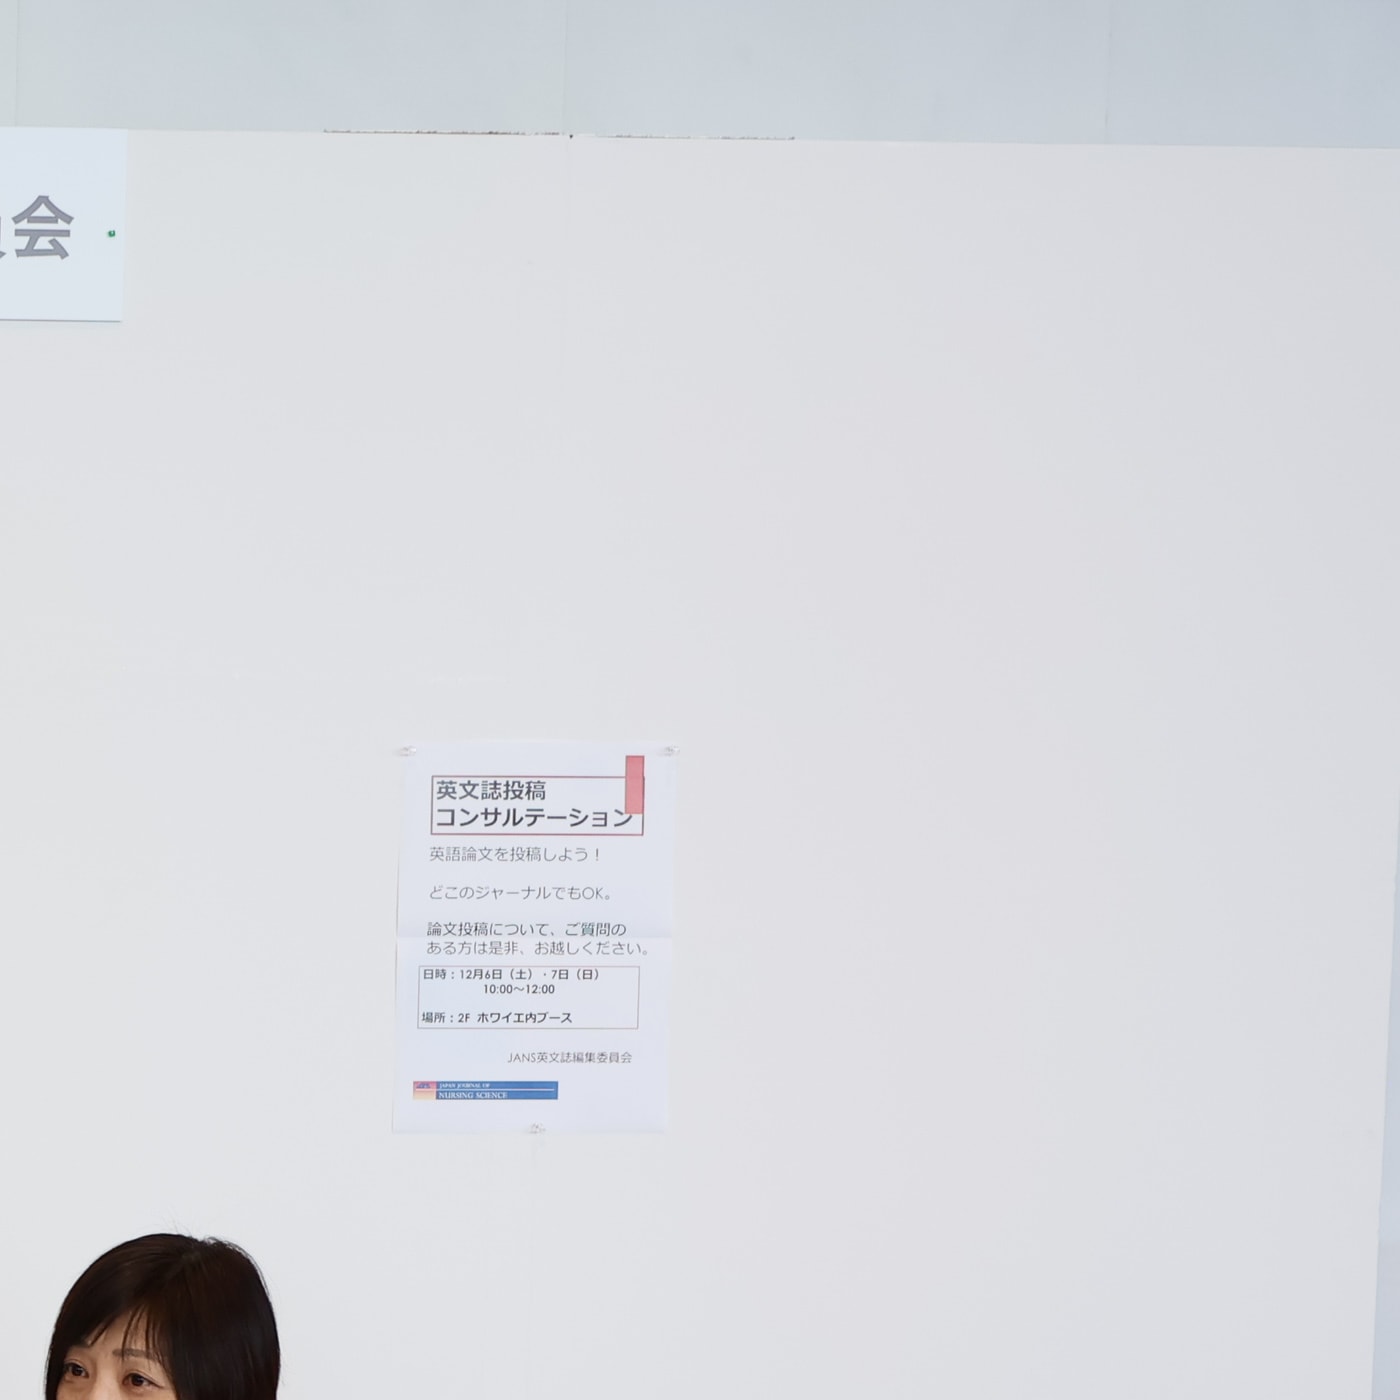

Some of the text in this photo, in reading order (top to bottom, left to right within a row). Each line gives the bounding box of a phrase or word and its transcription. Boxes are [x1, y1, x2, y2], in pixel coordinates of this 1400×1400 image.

[436, 780, 547, 800] 英文誌投稿
[436, 807, 633, 828] コンサルテーション
[429, 846, 600, 862] 英語論文を投稿しよう！
[429, 885, 611, 901] どこのジャーナルでもOK。
[426, 922, 627, 938] 論文投稿について、ご質問の
[426, 941, 648, 956] ある方は是非、お越しください。
[477, 1012, 573, 1024] ホワイエ内ブース
[507, 1051, 633, 1064] JANS英文誌編集委員会
